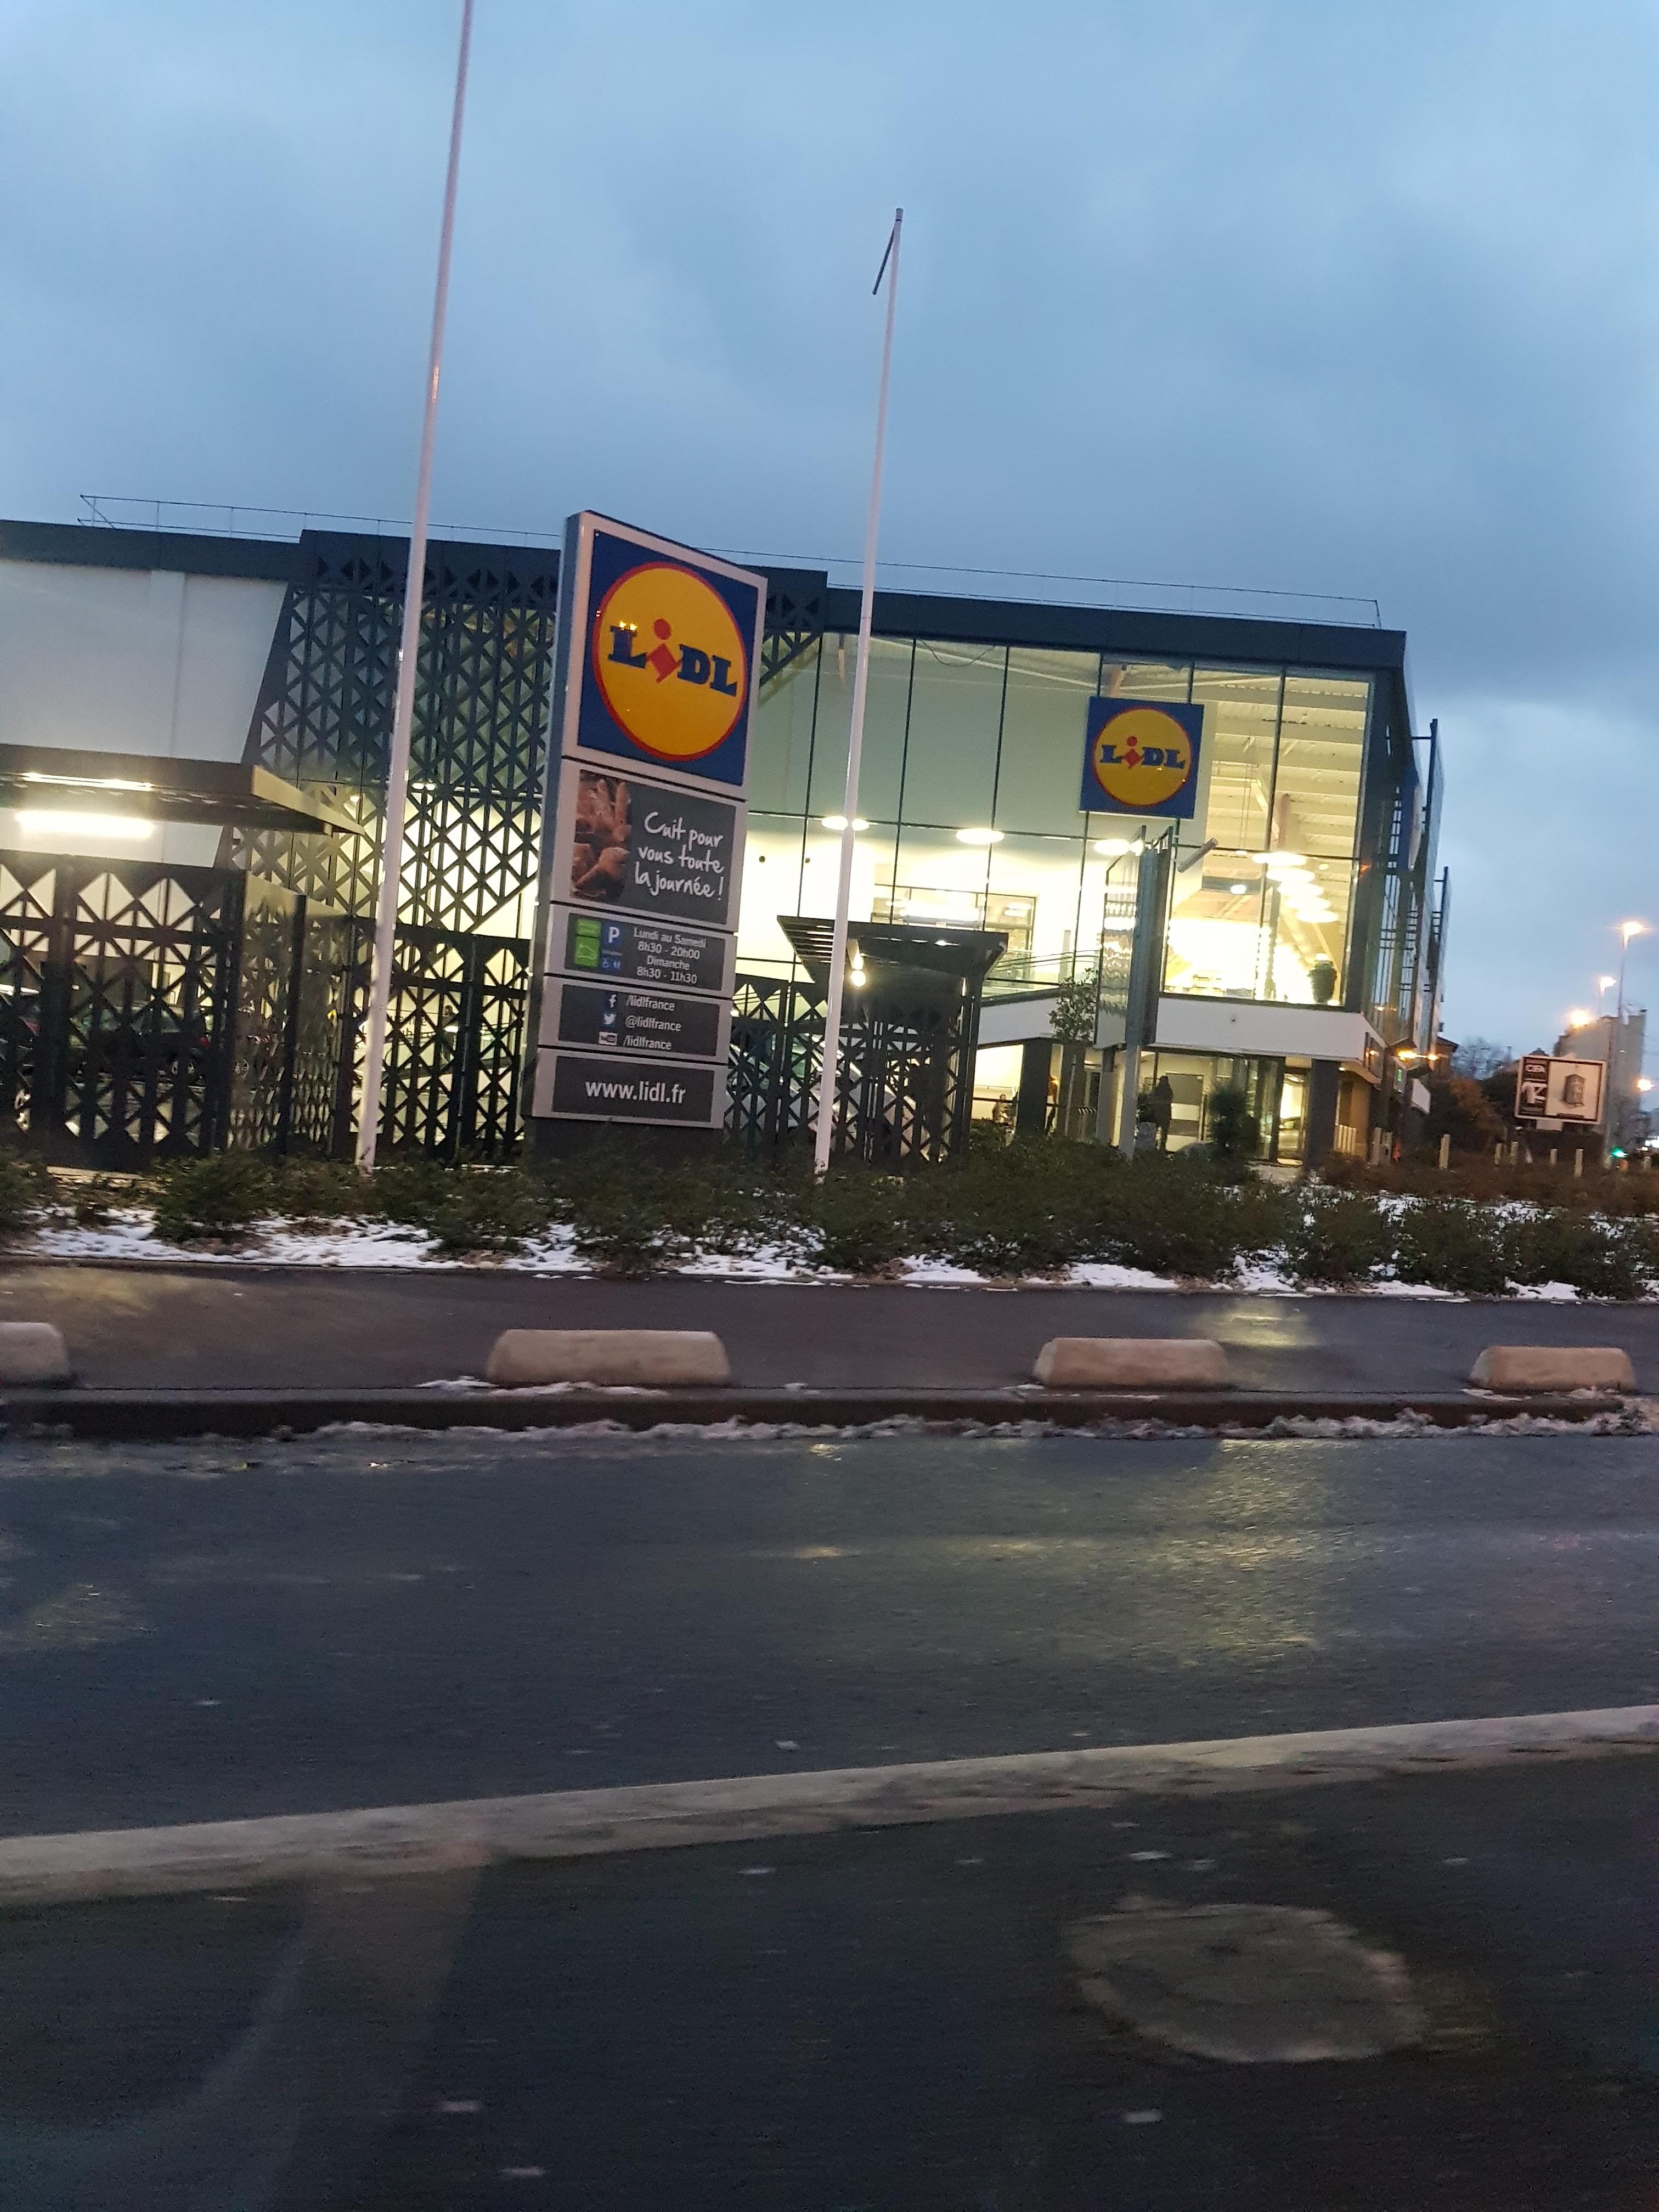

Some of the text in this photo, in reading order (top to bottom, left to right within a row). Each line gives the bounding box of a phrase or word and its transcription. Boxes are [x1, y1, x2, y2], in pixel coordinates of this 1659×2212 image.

[644, 812, 723, 850] Cuit pour
[638, 844, 725, 873] vous toute
[634, 862, 651, 887] la
[651, 870, 716, 898] journée
[634, 927, 707, 948] Lundi au Samedi
[637, 941, 662, 954] 8h30
[671, 946, 701, 960] 20h00
[637, 966, 661, 979] 8h30
[646, 956, 690, 970] Dimanche
[624, 1015, 682, 1031] @lidlfrance
[585, 1080, 686, 1104] www.lidl.fr
